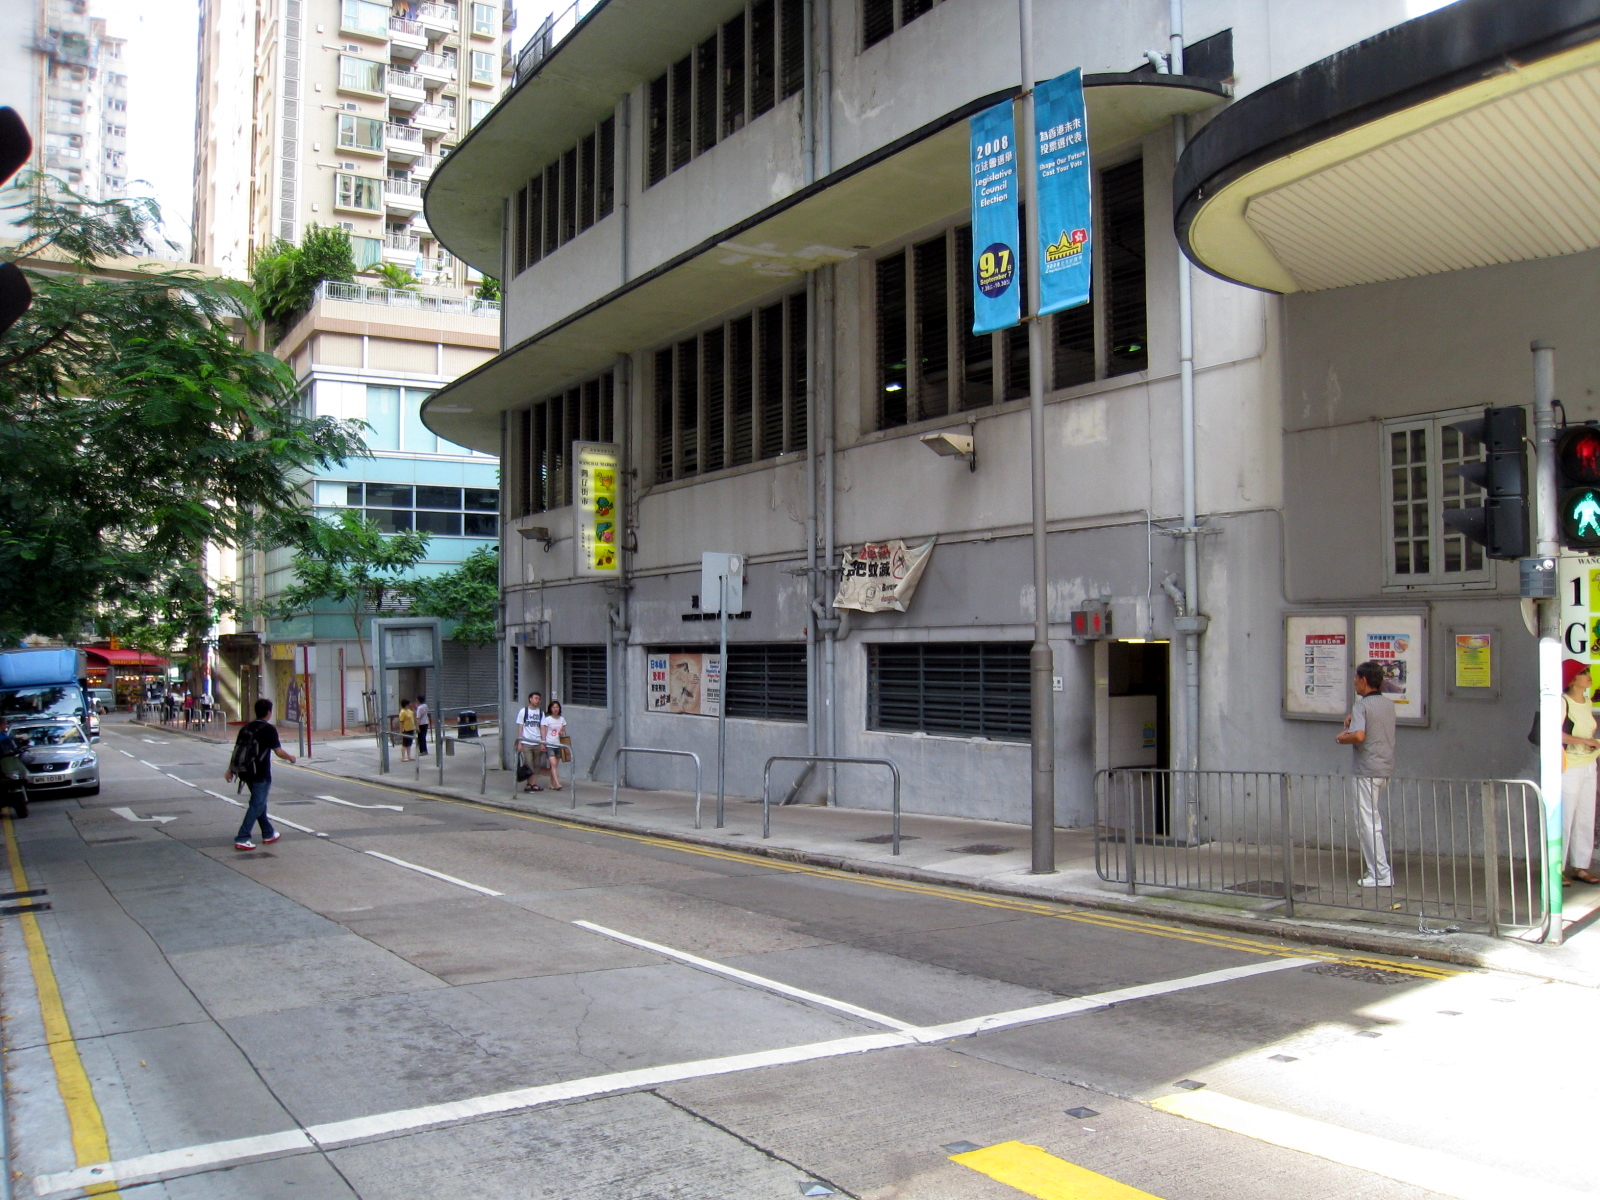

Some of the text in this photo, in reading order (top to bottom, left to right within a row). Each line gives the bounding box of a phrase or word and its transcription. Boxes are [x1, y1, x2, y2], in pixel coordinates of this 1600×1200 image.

[1040, 118, 1082, 142] 為香港未來
[977, 135, 1009, 160] 2008
[1040, 131, 1083, 155] 投票選代表
[1056, 157, 1067, 165] Our
[1067, 151, 1086, 161] Future
[975, 168, 1013, 187] Legislative
[1042, 160, 1083, 178] Cast Your Vote
[981, 180, 1008, 196] Council
[980, 193, 1008, 208] Election
[980, 273, 1007, 286] September
[1564, 622, 1588, 655] G
